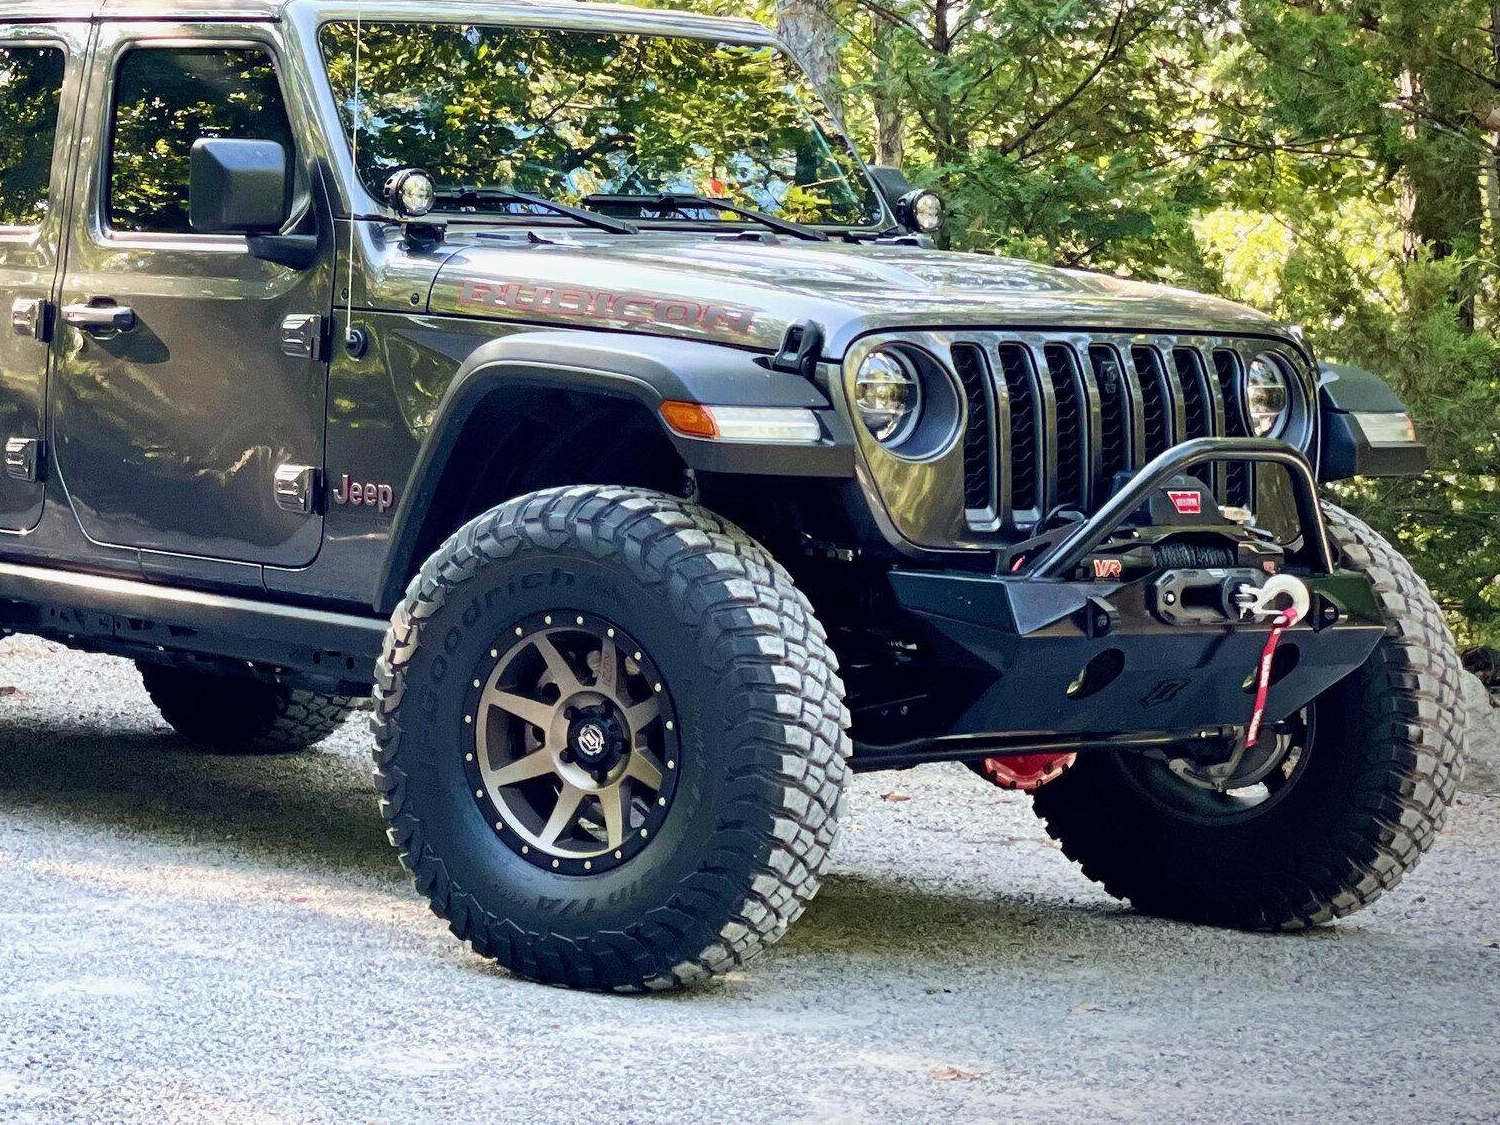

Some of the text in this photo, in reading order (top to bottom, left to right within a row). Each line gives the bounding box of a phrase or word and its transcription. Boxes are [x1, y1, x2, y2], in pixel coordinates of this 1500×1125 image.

[459, 280, 757, 333] RUBICON
[332, 474, 393, 514] Jeep
[1093, 559, 1122, 578] VR
